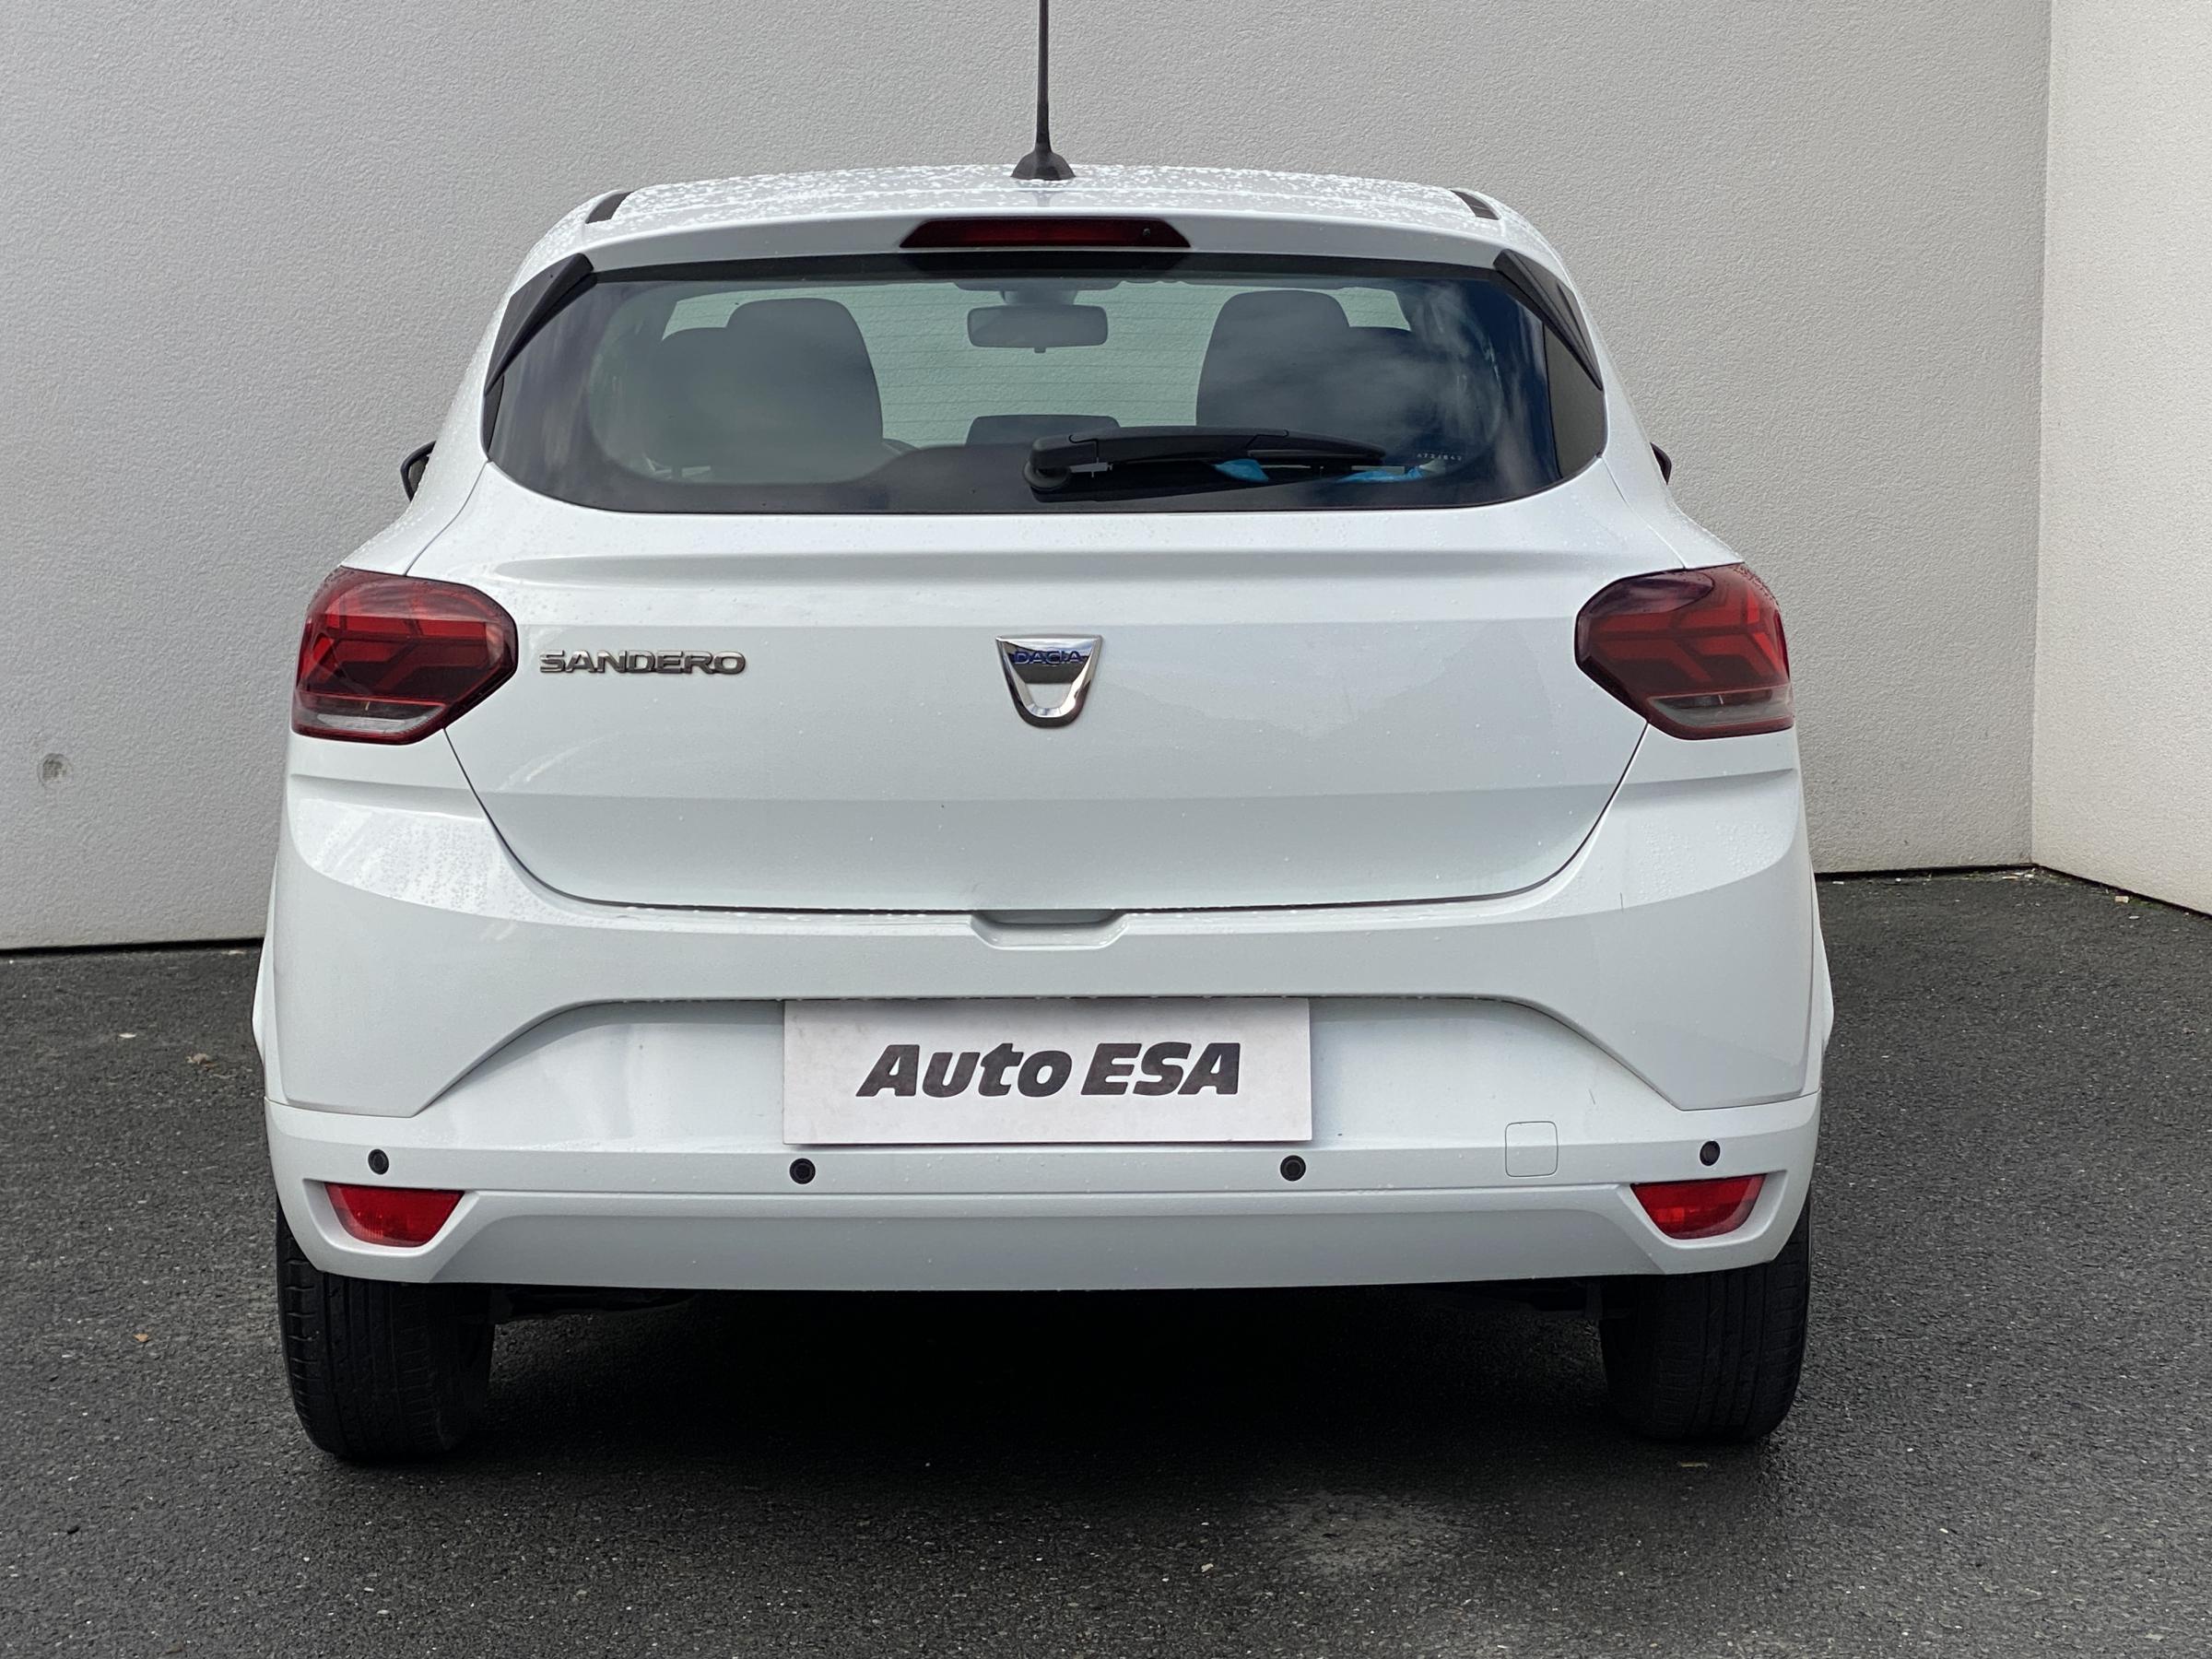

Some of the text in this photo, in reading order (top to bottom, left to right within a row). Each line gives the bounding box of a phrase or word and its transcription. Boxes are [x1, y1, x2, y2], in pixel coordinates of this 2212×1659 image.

[539, 649, 746, 675] SANDERO
[1015, 650, 1082, 665] DACIA
[855, 1041, 1241, 1098] Auto ESA
